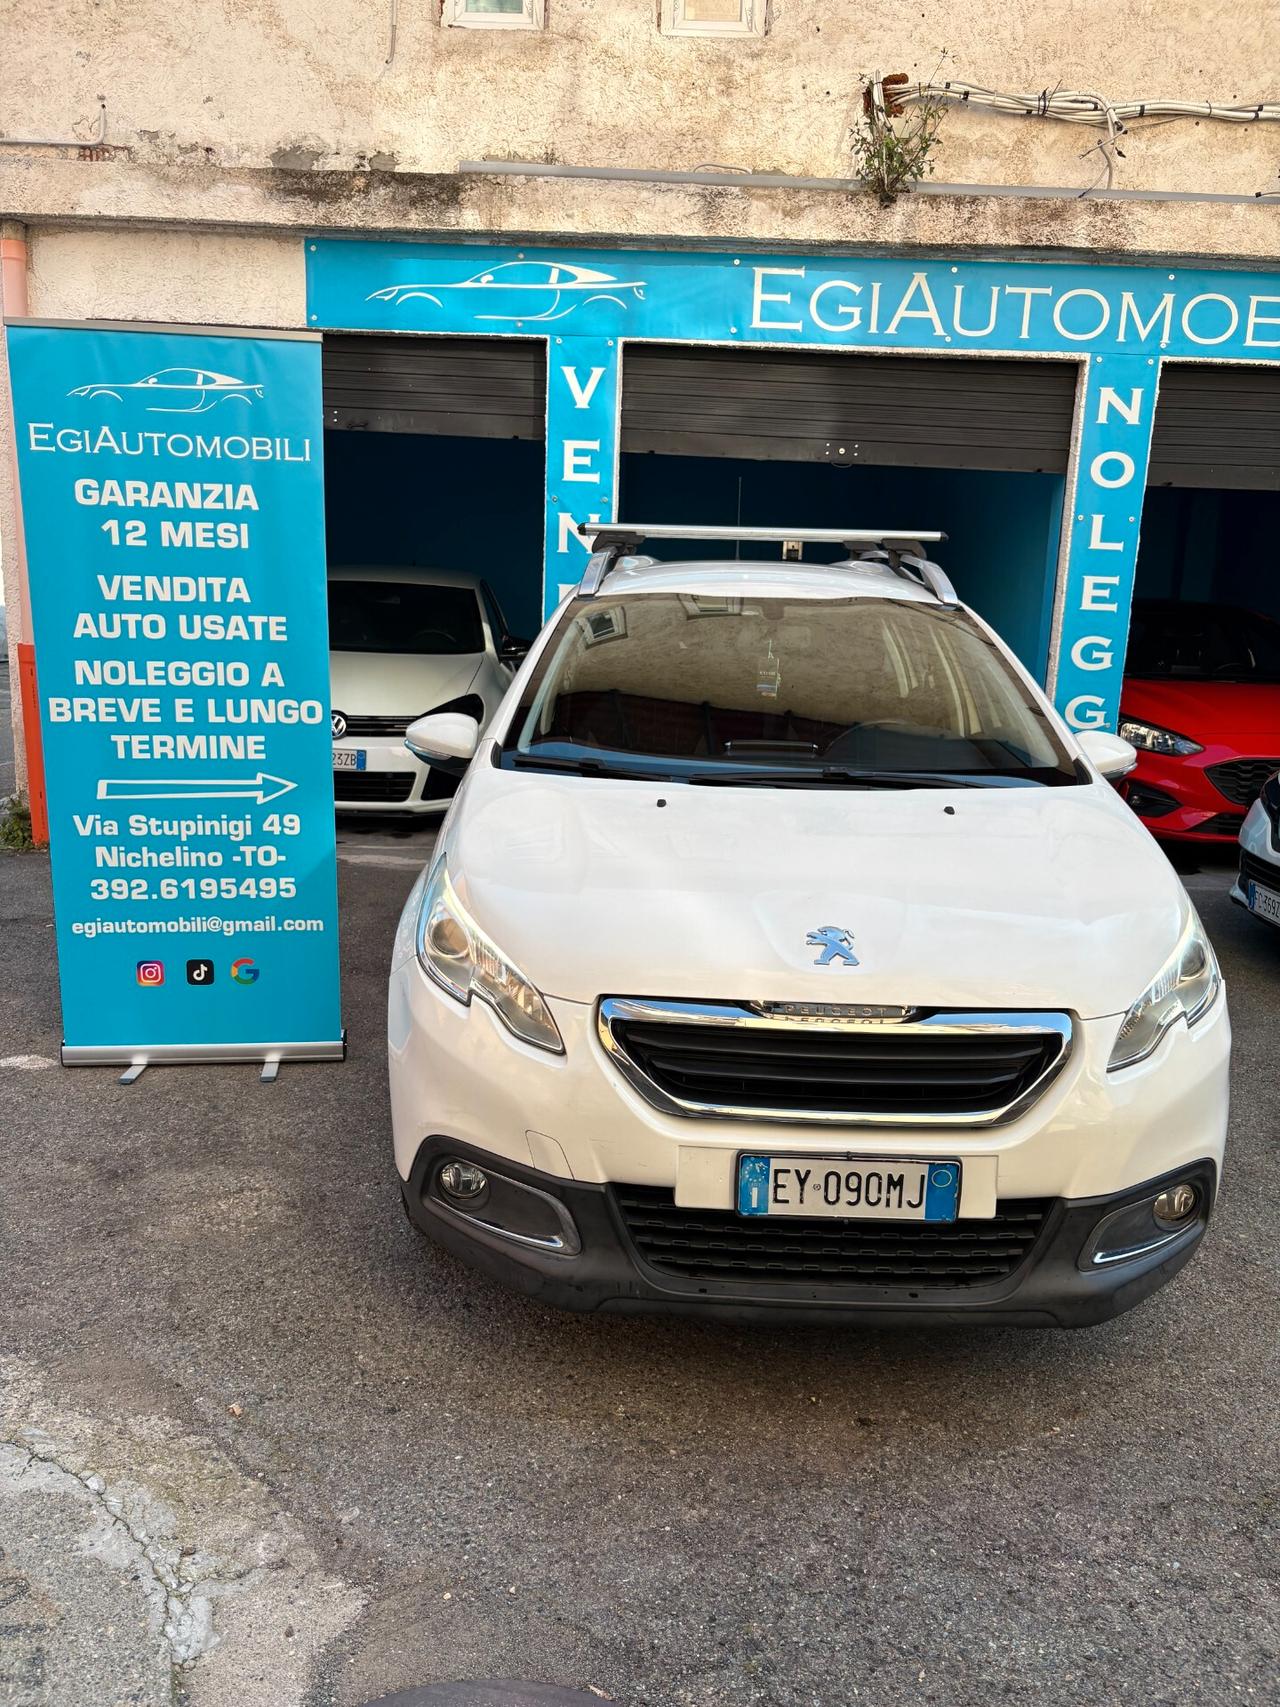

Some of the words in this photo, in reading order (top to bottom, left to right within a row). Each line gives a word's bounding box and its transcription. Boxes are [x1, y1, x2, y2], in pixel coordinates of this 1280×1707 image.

[74, 478, 259, 511] GARANZIA
[101, 520, 147, 547] 12
[161, 521, 249, 549] MESI
[97, 575, 251, 603] VENDITA
[73, 613, 166, 639] AUTO
[179, 615, 288, 641] USATE
[75, 660, 250, 687] NOLEGGIO
[261, 662, 285, 687] A
[48, 697, 162, 723] BREVE
[175, 698, 194, 723] E
[207, 698, 323, 725] LUNGO
[111, 735, 266, 760] TERMINE
[73, 814, 119, 836] Via
[129, 814, 251, 841] Stupinigi
[262, 813, 301, 836] 49
[96, 846, 223, 868] Nichelino
[232, 846, 286, 867] -TO-
[90, 877, 297, 900] 392.6195495
[72, 916, 324, 938] egiautomobili@gmail.com
